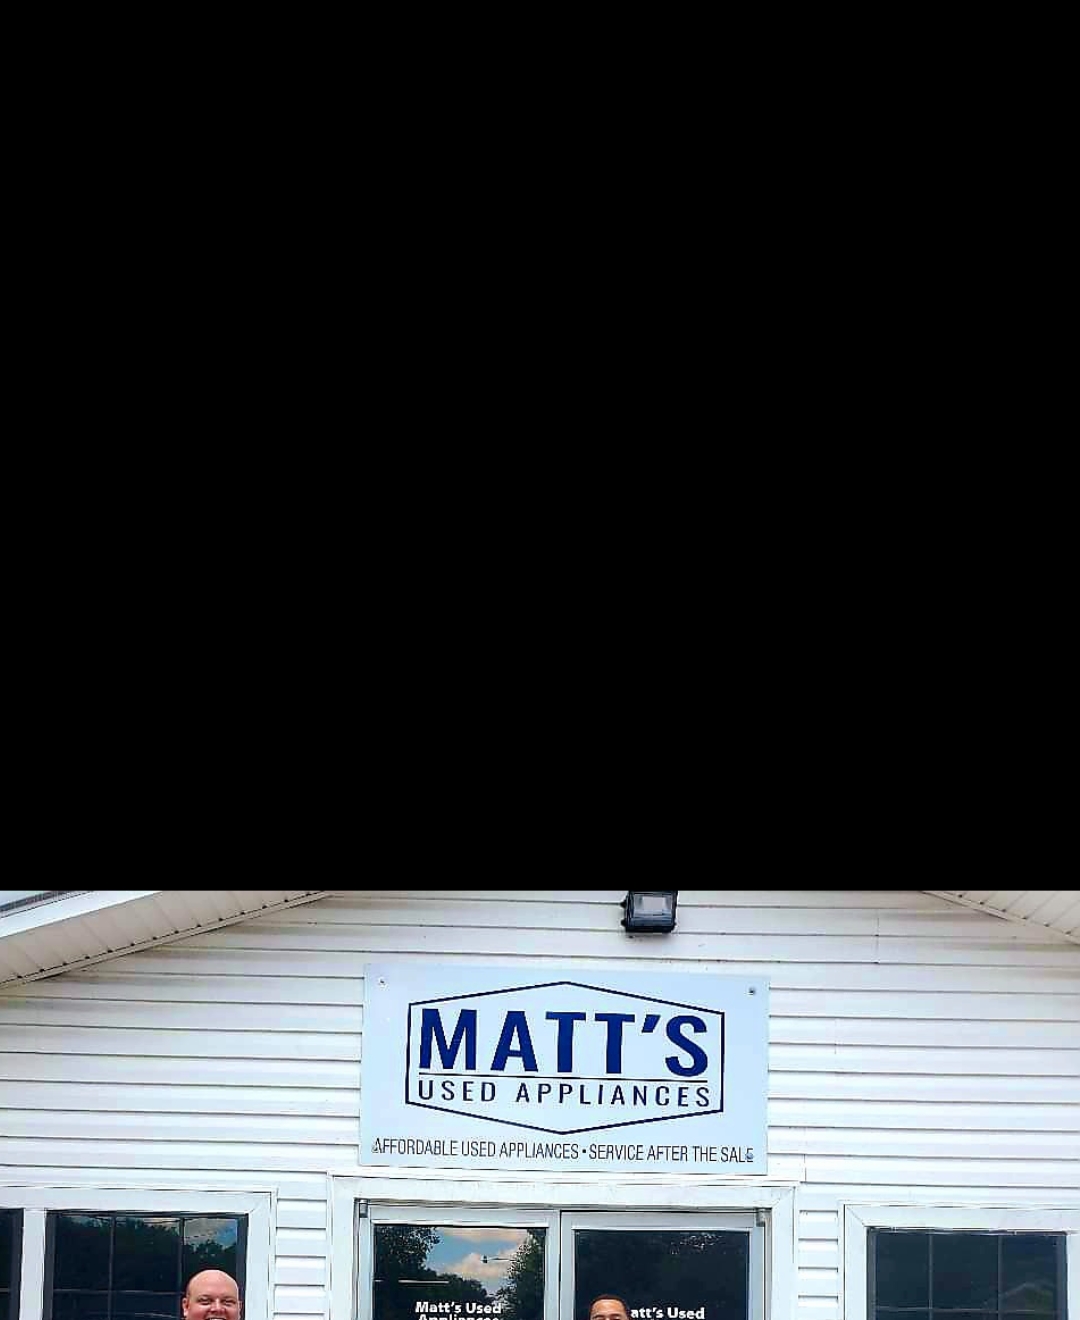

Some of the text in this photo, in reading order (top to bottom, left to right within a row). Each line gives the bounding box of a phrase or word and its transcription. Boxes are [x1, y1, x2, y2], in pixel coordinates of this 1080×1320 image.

[419, 1008, 708, 1077] MATT'S
[418, 1080, 710, 1107] USED APPLIANCES
[371, 1138, 754, 1163] AFFORDABLE USED APPLIANCES SERVICE AFTER THE SALE
[415, 1301, 502, 1314] Matt's Used
[630, 1307, 705, 1319] att's Used
